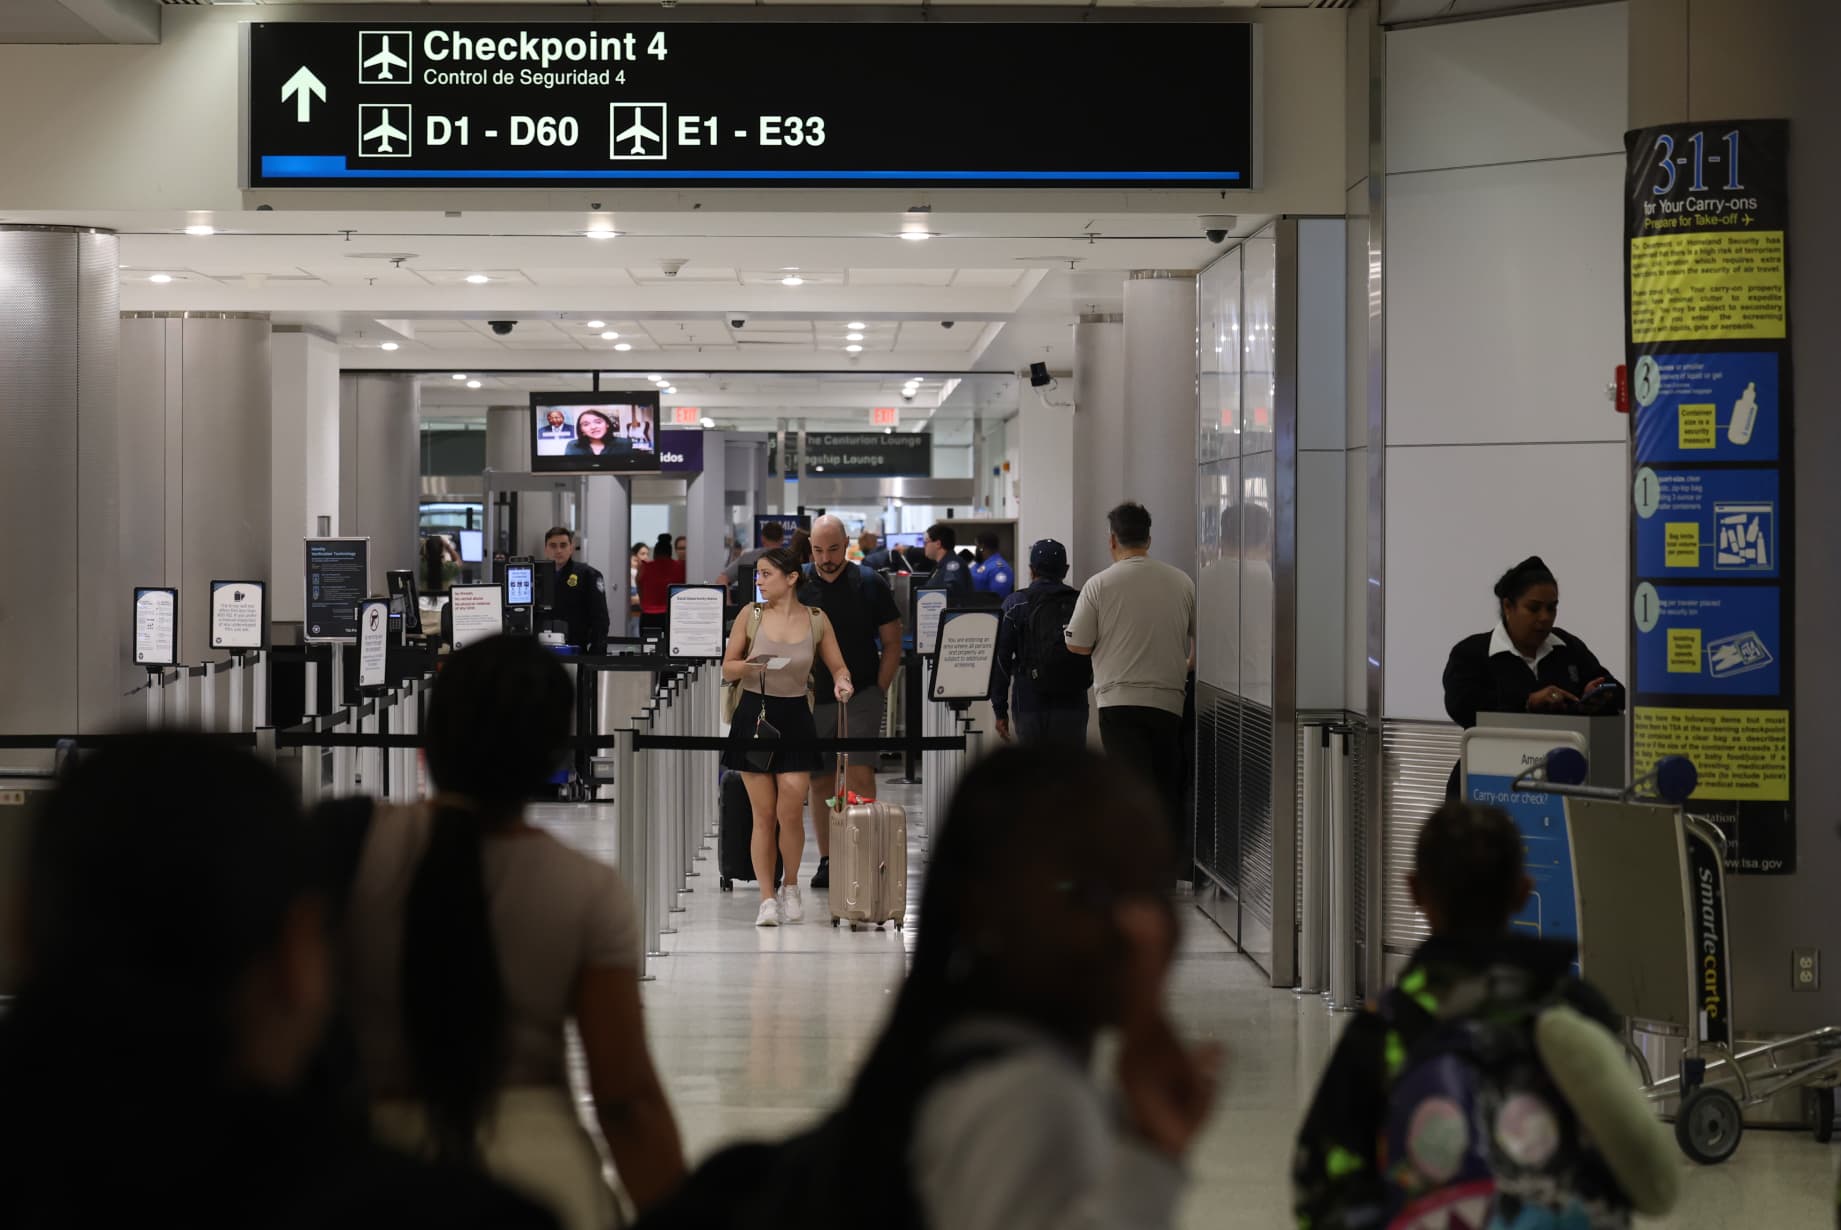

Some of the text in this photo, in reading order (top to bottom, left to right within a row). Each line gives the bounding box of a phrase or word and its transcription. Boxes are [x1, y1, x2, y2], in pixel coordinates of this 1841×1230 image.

[423, 30, 668, 68] Checkpoint 4
[423, 68, 626, 89] Control de Seguridad 4
[426, 115, 579, 147] D1 - D60
[678, 115, 826, 147] E1 - E33
[1652, 130, 1745, 195] 3-1-1
[1644, 196, 1757, 214] for Your Carry-ons
[1644, 214, 1738, 229] Prepare for Take-off
[675, 406, 698, 425] EXIT
[873, 406, 896, 425] EXIT
[823, 434, 922, 448] Centurion Lounge
[842, 453, 884, 466] Lounge
[1472, 787, 1549, 806] Carry-on or check?
